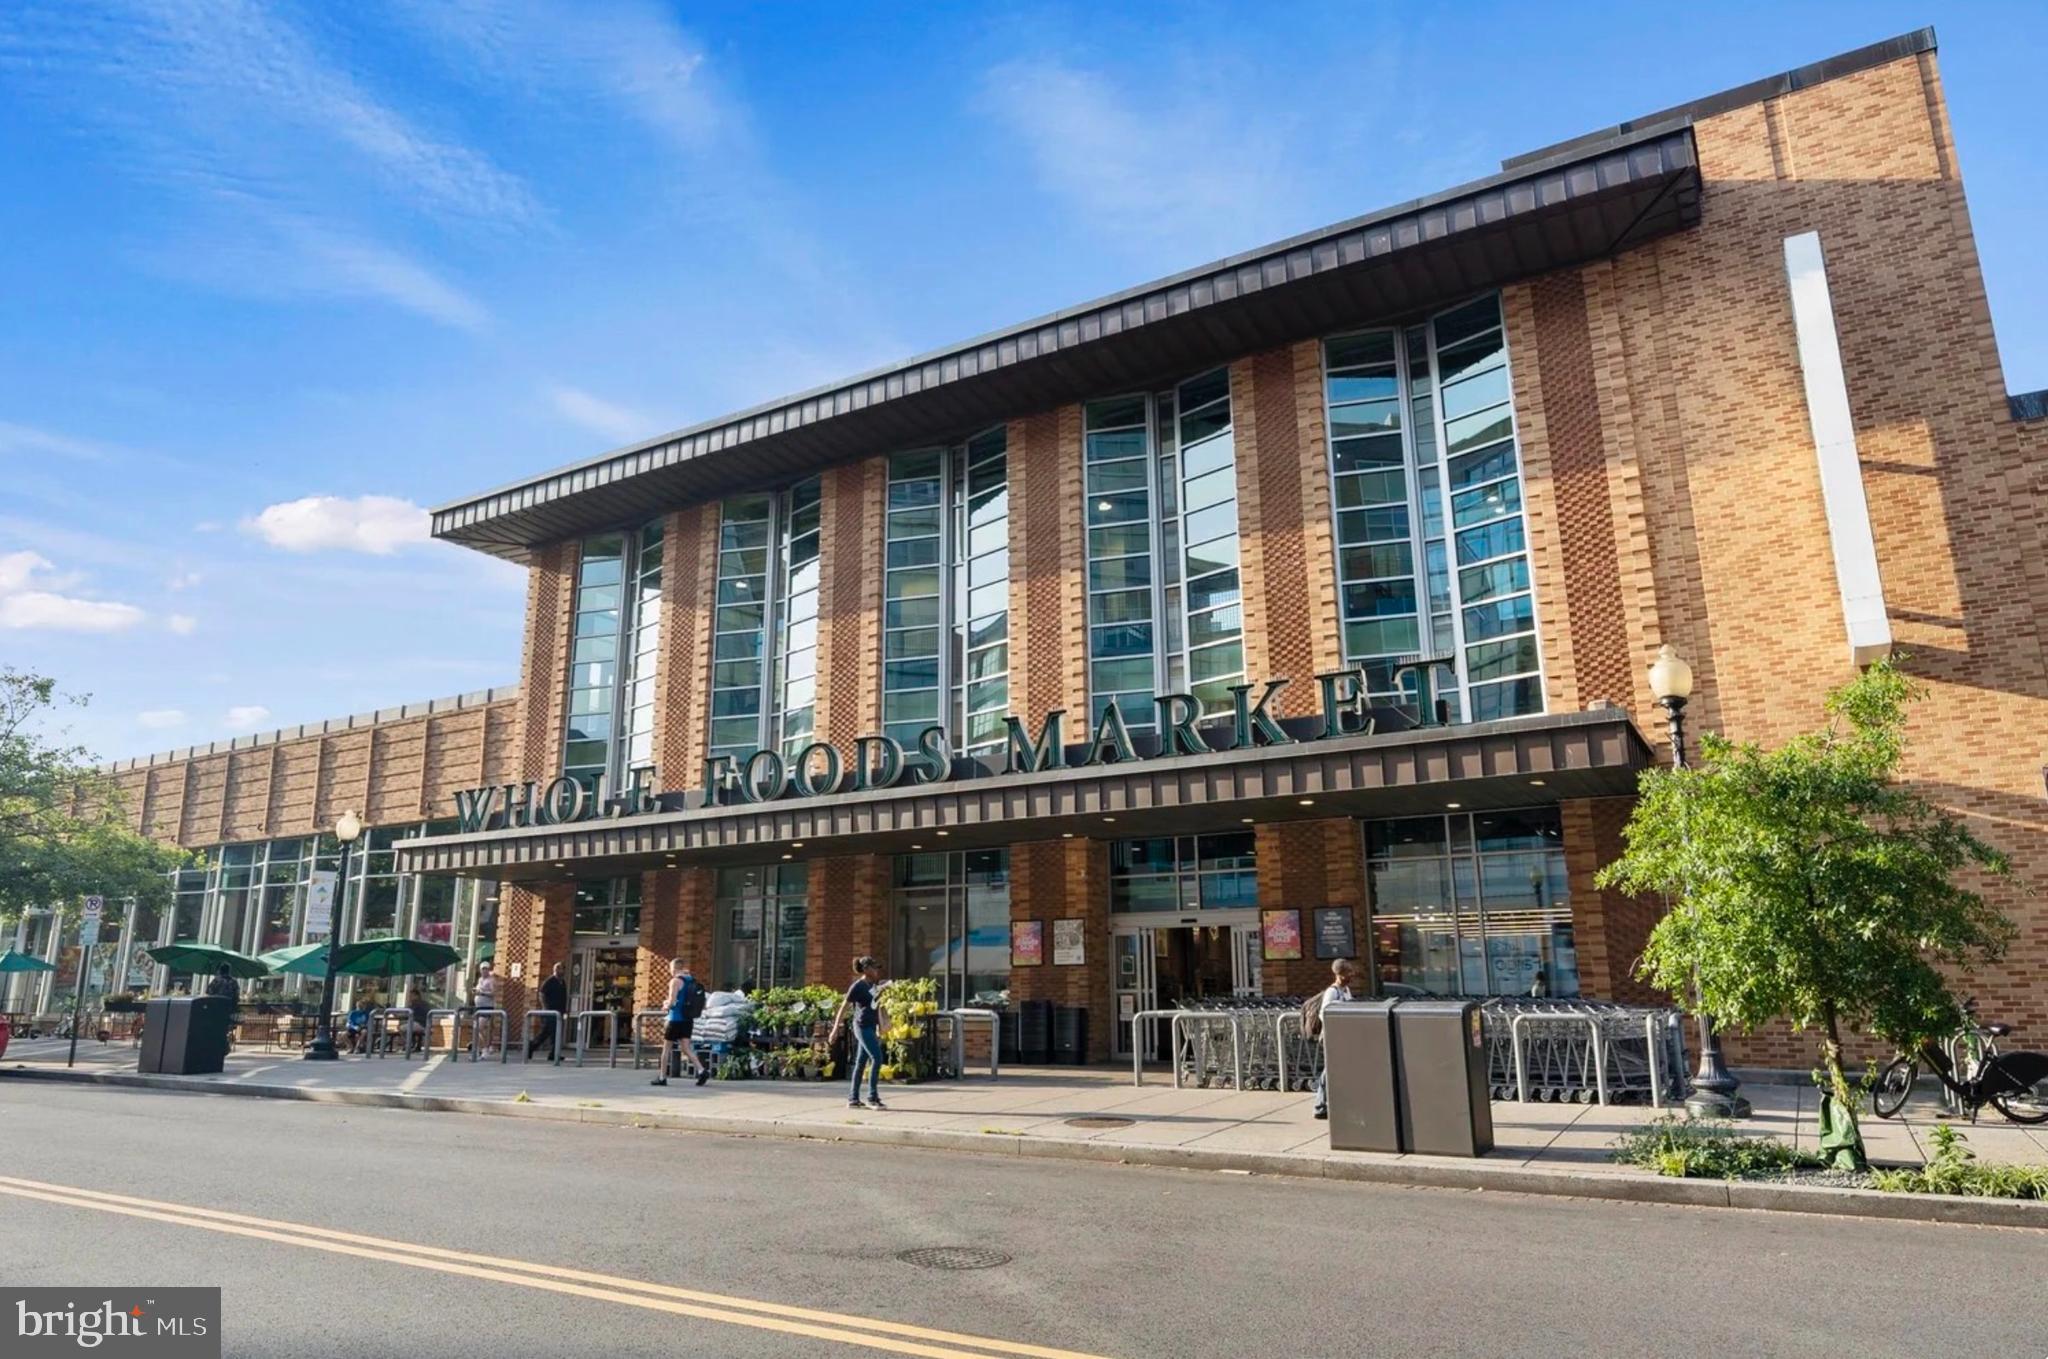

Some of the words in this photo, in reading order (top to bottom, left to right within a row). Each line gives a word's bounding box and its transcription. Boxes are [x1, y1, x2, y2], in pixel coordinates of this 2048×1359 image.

[454, 766, 662, 834] WHOLE
[700, 725, 953, 808] FOODS
[1001, 654, 1456, 775] MARKET
